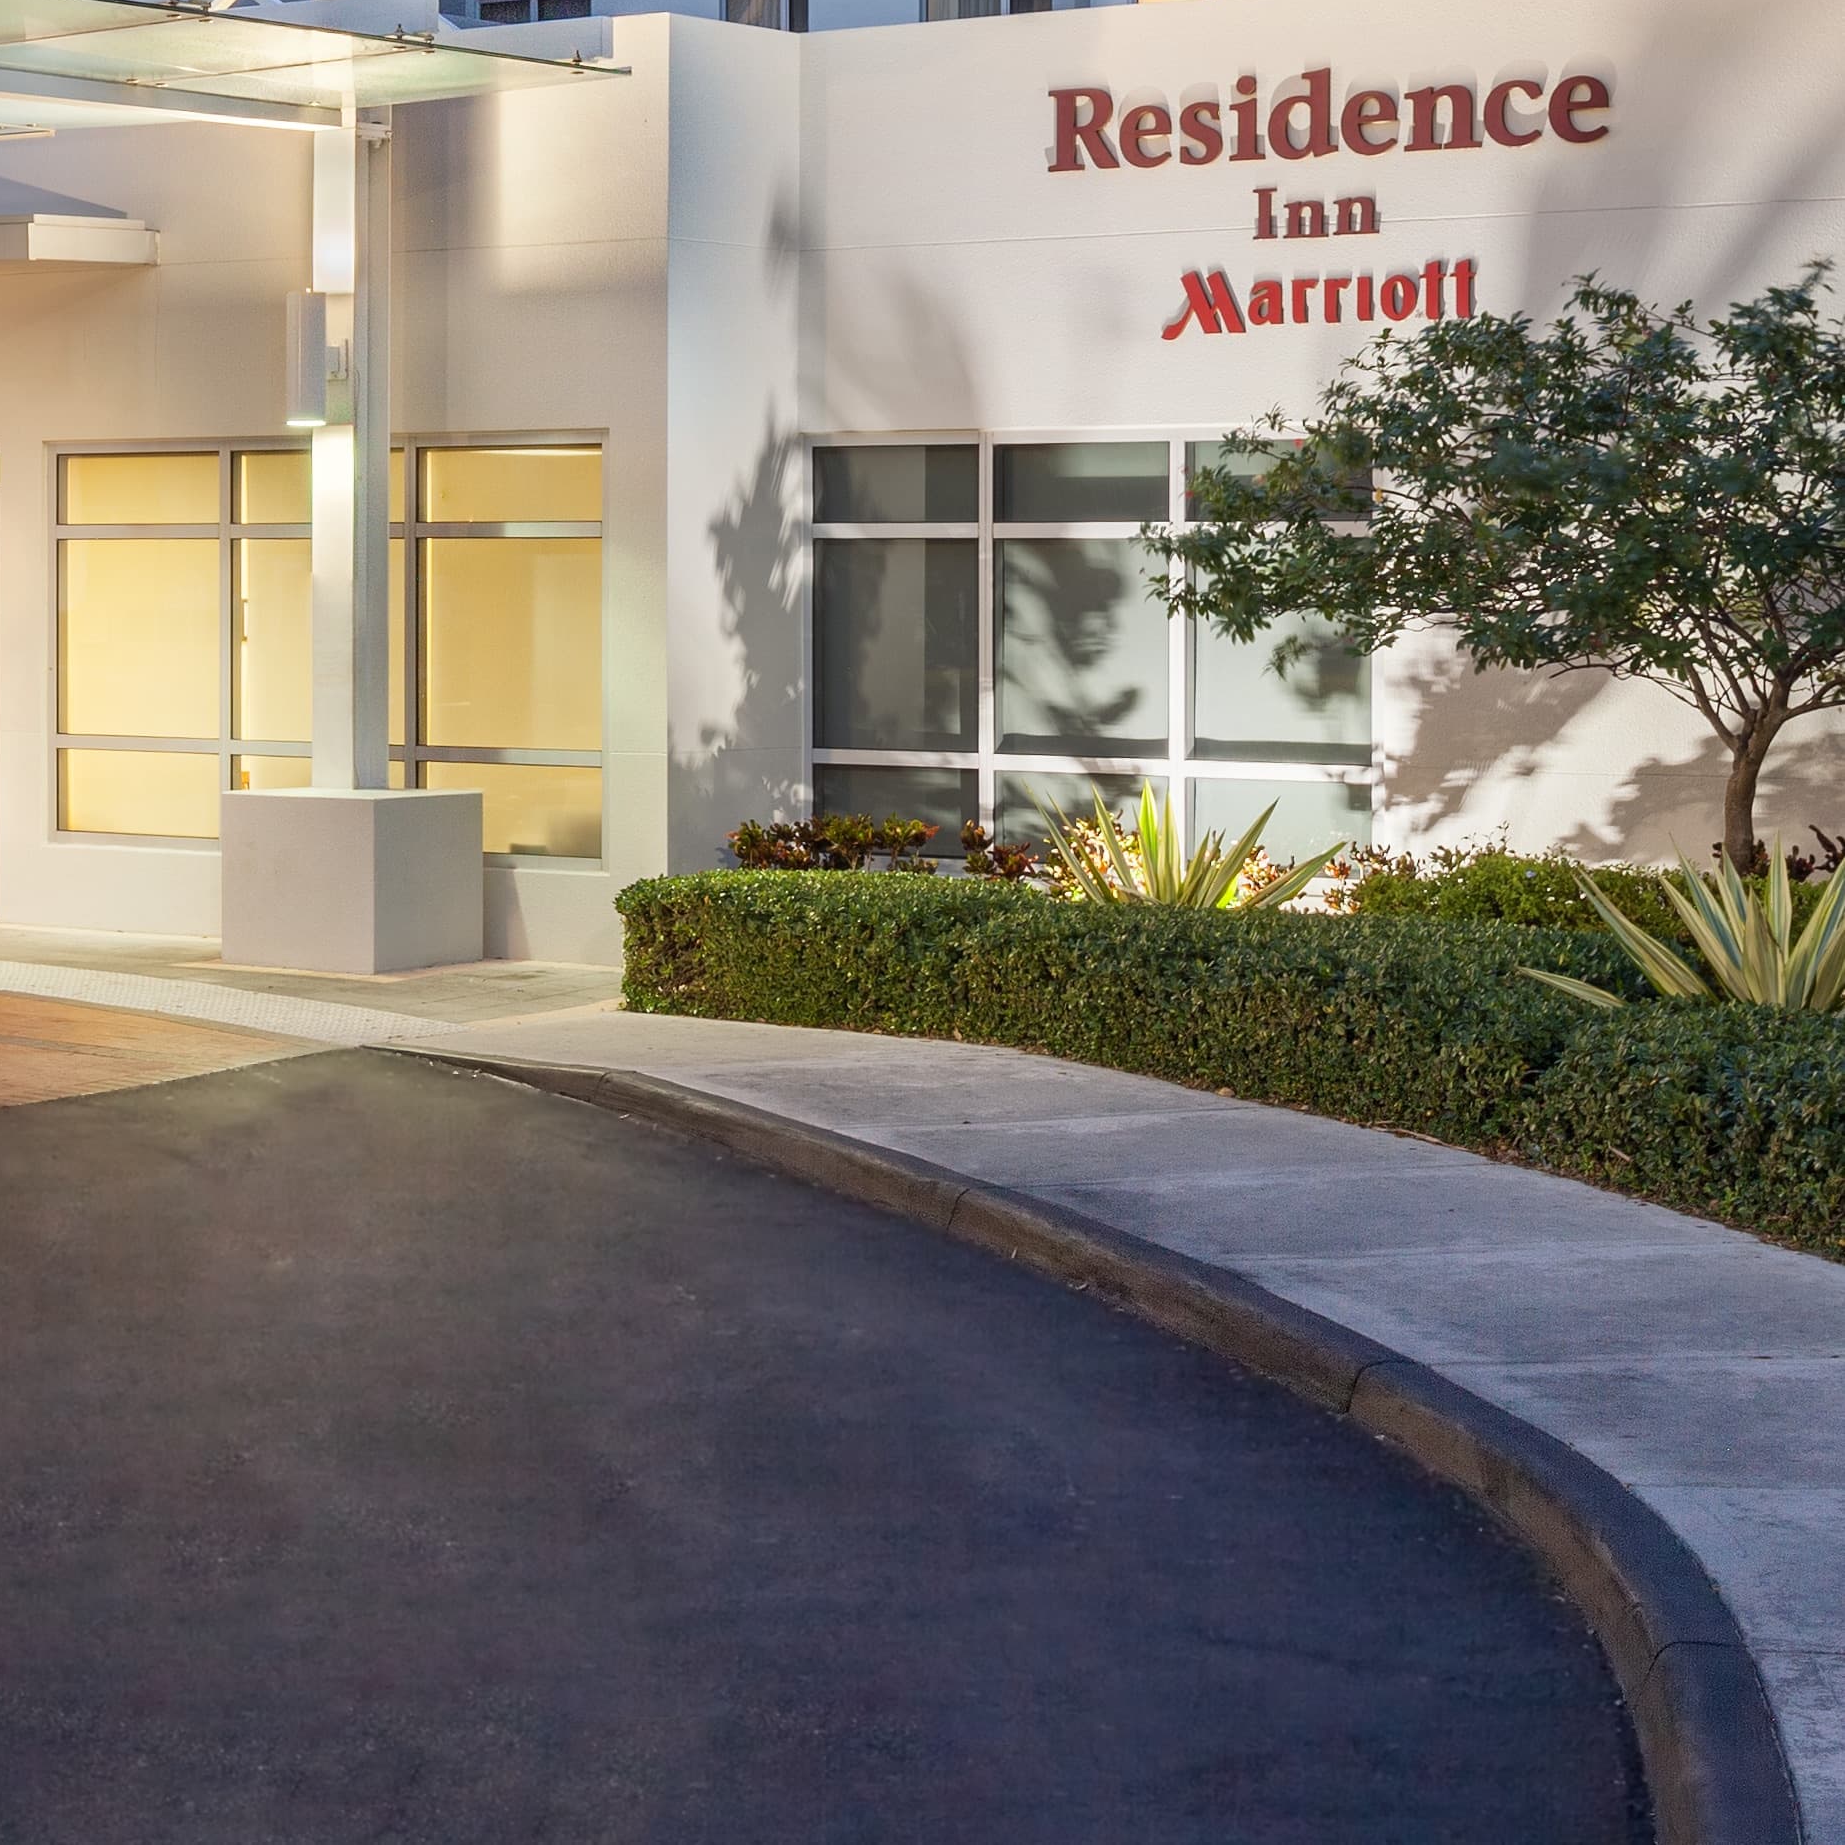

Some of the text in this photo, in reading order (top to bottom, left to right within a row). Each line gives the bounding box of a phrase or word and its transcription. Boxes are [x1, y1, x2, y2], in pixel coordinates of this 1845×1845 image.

[1047, 67, 1610, 173] Residence
[1252, 187, 1379, 240] Inn
[1160, 258, 1477, 341] Marriott
